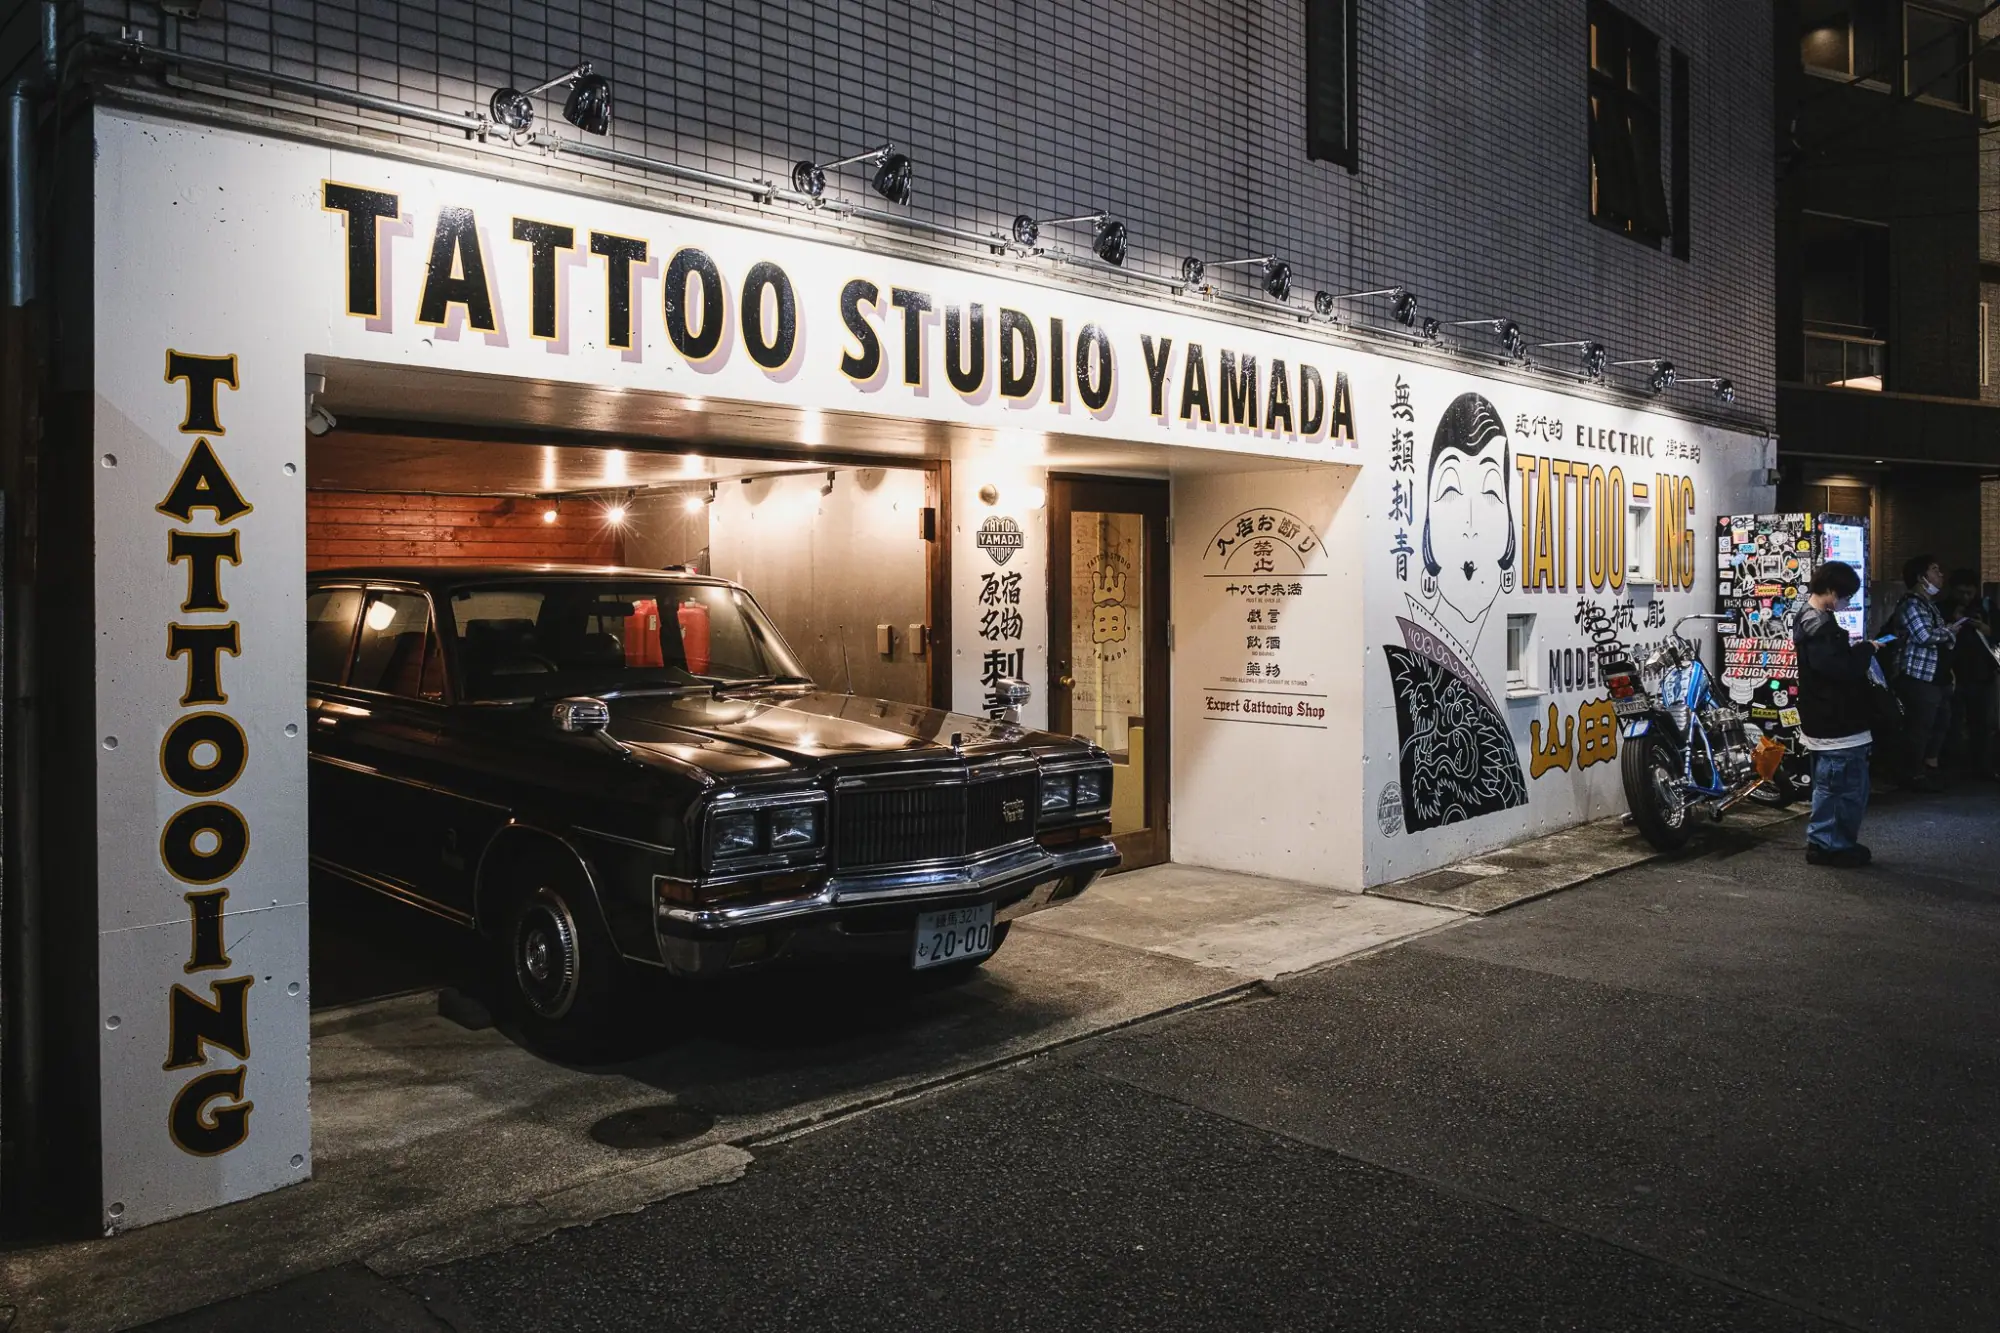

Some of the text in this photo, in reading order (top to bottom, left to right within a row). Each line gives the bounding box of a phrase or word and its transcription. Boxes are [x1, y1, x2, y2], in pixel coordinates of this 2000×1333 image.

[321, 178, 1357, 442] TATTOO STUDIO YAMADA
[1576, 424, 1655, 459] ELECTRIC
[985, 518, 1015, 532] TATTOO
[979, 534, 1021, 545] YAMADA
[989, 547, 1012, 561] STUDIO
[1086, 552, 1109, 570] TATTO
[1765, 639, 1795, 651] VMRS
[1093, 647, 1127, 662] YAMADA
[1766, 653, 1798, 665] 2024.11
[1205, 696, 1325, 720] Expert Tattooing Shop
[1530, 697, 1618, 779] 山田
[155, 349, 254, 1156] TATTOOING
[959, 908, 977, 924] 321
[930, 923, 989, 961] 20-00
